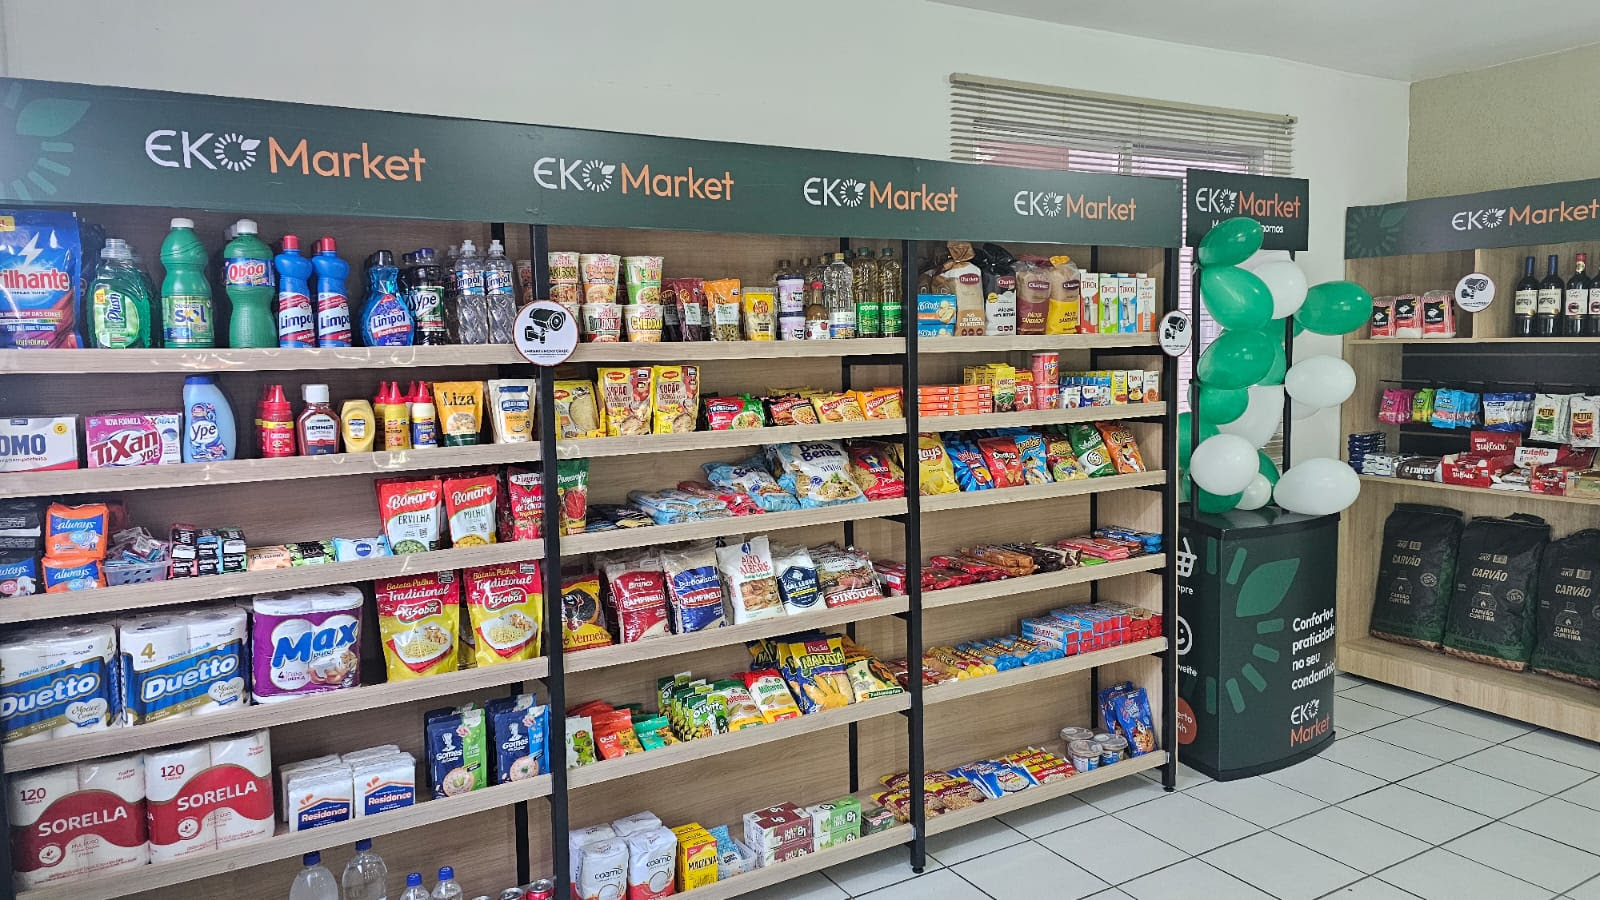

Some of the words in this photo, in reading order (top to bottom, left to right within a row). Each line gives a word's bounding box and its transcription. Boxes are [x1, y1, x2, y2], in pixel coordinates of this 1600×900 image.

[145, 129, 261, 172] EKO
[268, 136, 426, 181] Market
[533, 157, 616, 192] EKO
[620, 162, 734, 200] Market
[803, 177, 866, 207] EKO
[869, 180, 958, 213] Market
[1014, 190, 1065, 217] EKO
[1066, 193, 1136, 221] Market
[1195, 187, 1238, 214] EKO
[1238, 190, 1301, 219] Market
[1451, 207, 1506, 231] EKO
[1508, 198, 1600, 226] Market
[0, 269, 70, 291] ilhante
[281, 314, 312, 329] Limpo
[373, 312, 405, 328] Limpol
[444, 391, 476, 407] Liza
[0, 434, 46, 456] OMO
[800, 442, 833, 453] Dona
[801, 450, 842, 462] Benta
[1521, 449, 1549, 458] nutella
[515, 473, 541, 485] Fugin
[387, 489, 437, 510] Bonare
[453, 484, 493, 506] Bonare
[56, 521, 96, 531] always
[398, 513, 432, 525] ERVILHA
[1392, 554, 1421, 567] CARVÃO
[0, 567, 28, 578] ways
[54, 567, 91, 580] always
[1471, 567, 1508, 582] CARVÃO
[475, 575, 532, 591] Tradicional
[1177, 585, 1194, 596] mpre
[1554, 583, 1592, 598] CARVÃO
[388, 584, 449, 602] Tradicional
[830, 586, 881, 604] PINDUCA
[1292, 610, 1329, 633] Conforto
[1554, 626, 1580, 635] CARVÃO
[141, 642, 156, 660] 4
[272, 619, 357, 668] Max
[1292, 658, 1305, 672] no
[1305, 652, 1321, 667] seu
[145, 656, 237, 700] Duetto
[1178, 664, 1198, 677] veite
[0, 676, 96, 718] Duetto
[1177, 711, 1193, 724] erto
[1290, 698, 1321, 726] EKO
[1177, 723, 1187, 734] 4h
[1290, 712, 1330, 748] Market
[502, 738, 529, 750] Gomes
[436, 749, 462, 761] Gomes
[160, 764, 185, 778] 120
[20, 788, 46, 802] 120
[178, 780, 258, 812] SORELLA
[368, 792, 412, 806] Residence
[38, 806, 127, 837] SORELLA
[301, 807, 348, 822] Residence
[646, 854, 672, 868] coamo
[594, 866, 623, 880] coamo
